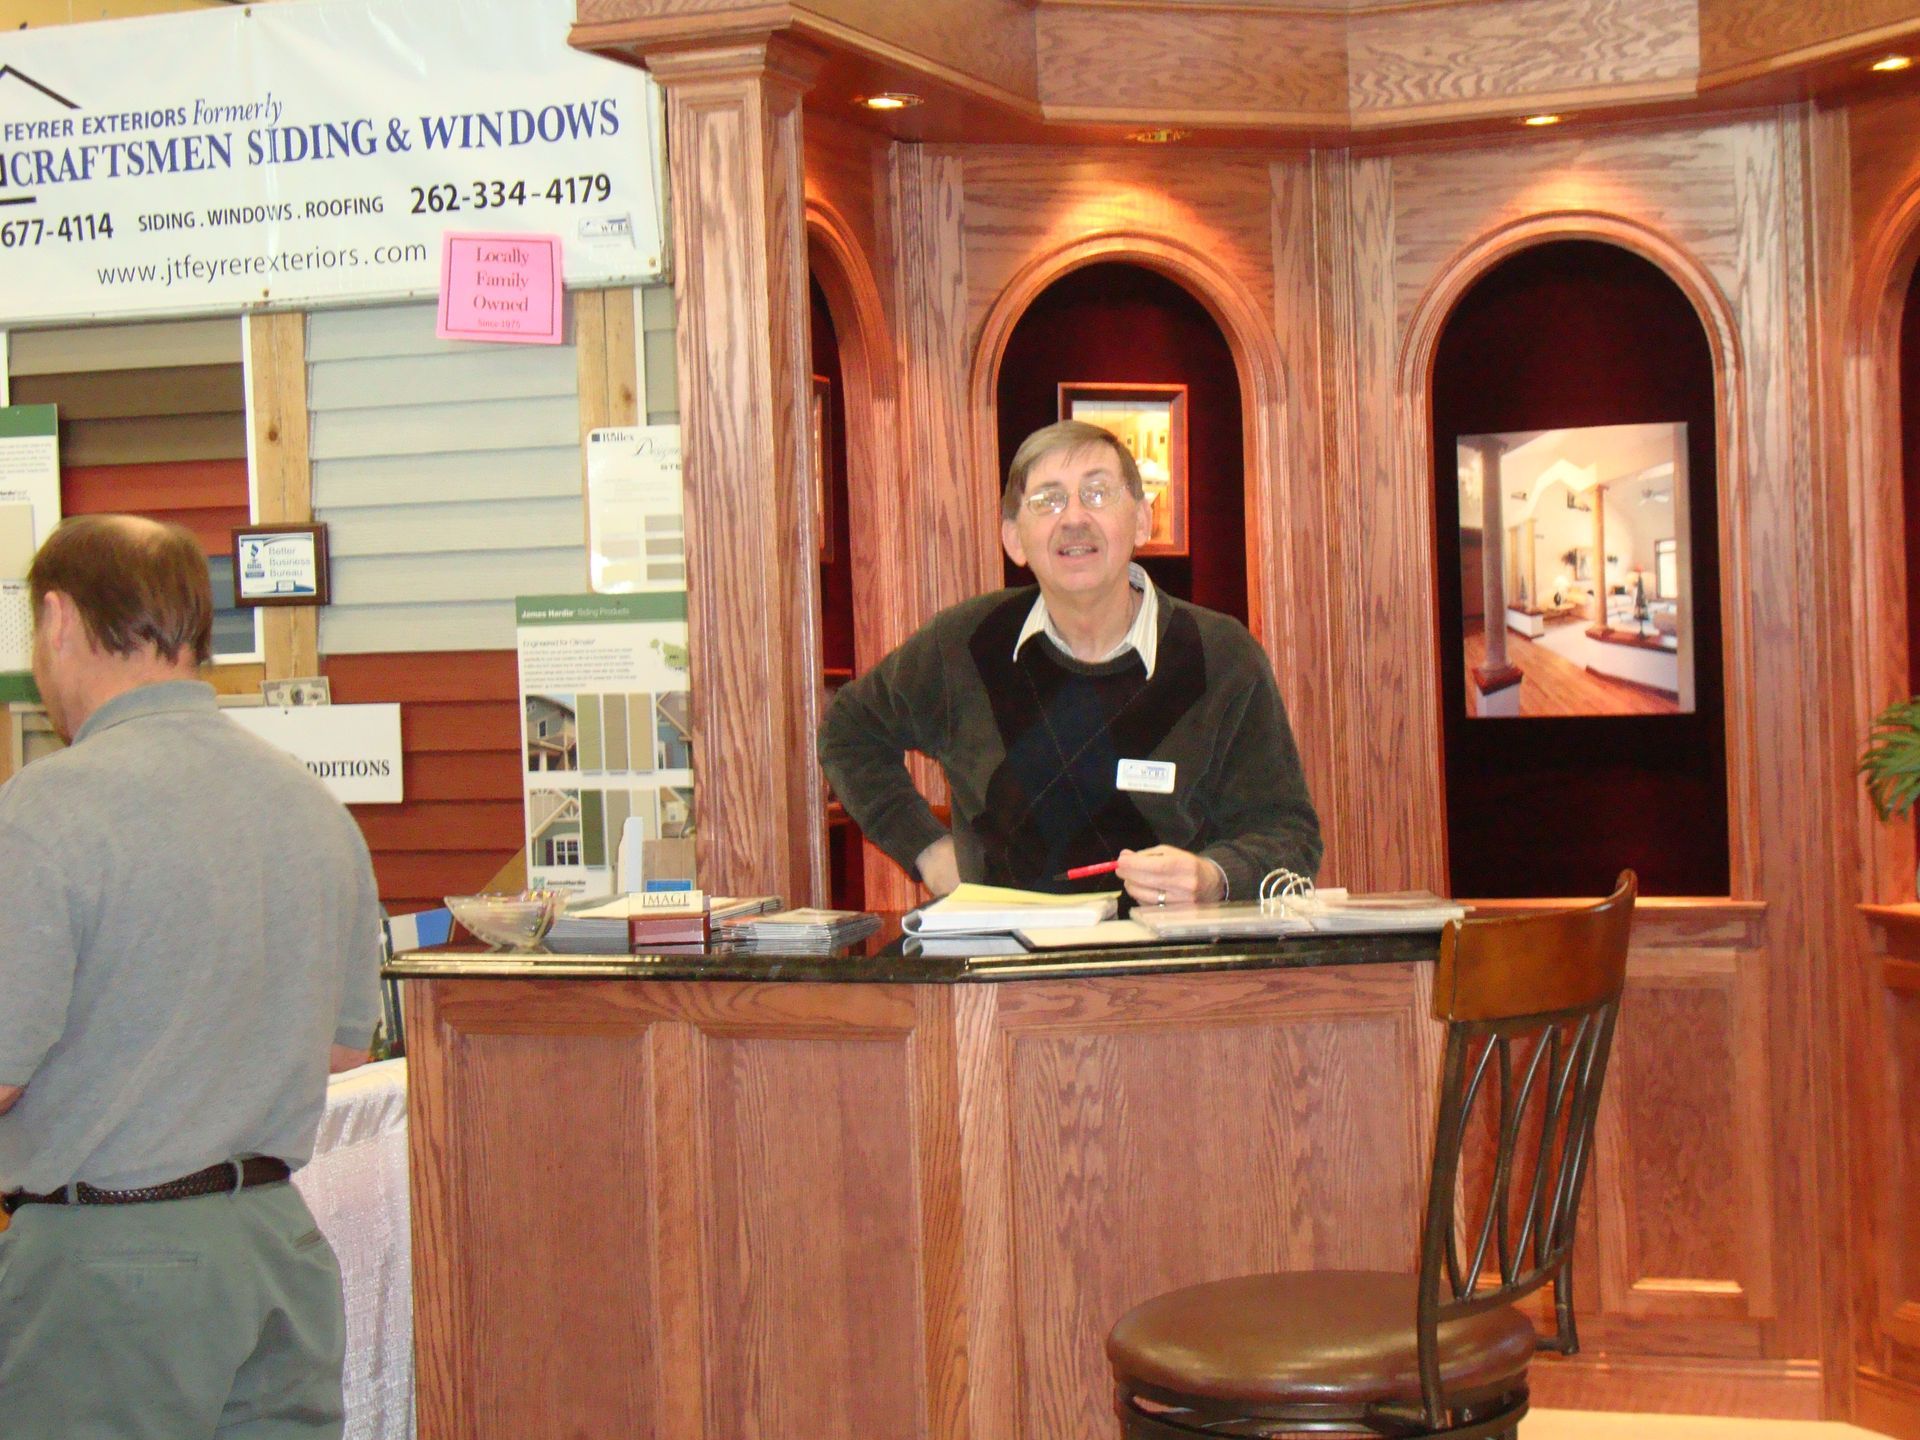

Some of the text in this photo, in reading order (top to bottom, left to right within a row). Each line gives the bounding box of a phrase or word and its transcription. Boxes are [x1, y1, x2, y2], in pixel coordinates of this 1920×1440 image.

[4, 92, 283, 143] FEYRER EXTERIORS Formerly
[10, 98, 620, 188] CRAFTSMEN SIDING & WINDOWS
[1, 212, 114, 248] 677-4114
[305, 196, 384, 219] ROOFING
[410, 173, 612, 214] 262-334-4179
[97, 243, 427, 286] www.jtfeyrerexteriors.com
[476, 247, 530, 267] Locally
[476, 271, 530, 291] Family
[473, 295, 529, 312] Owned
